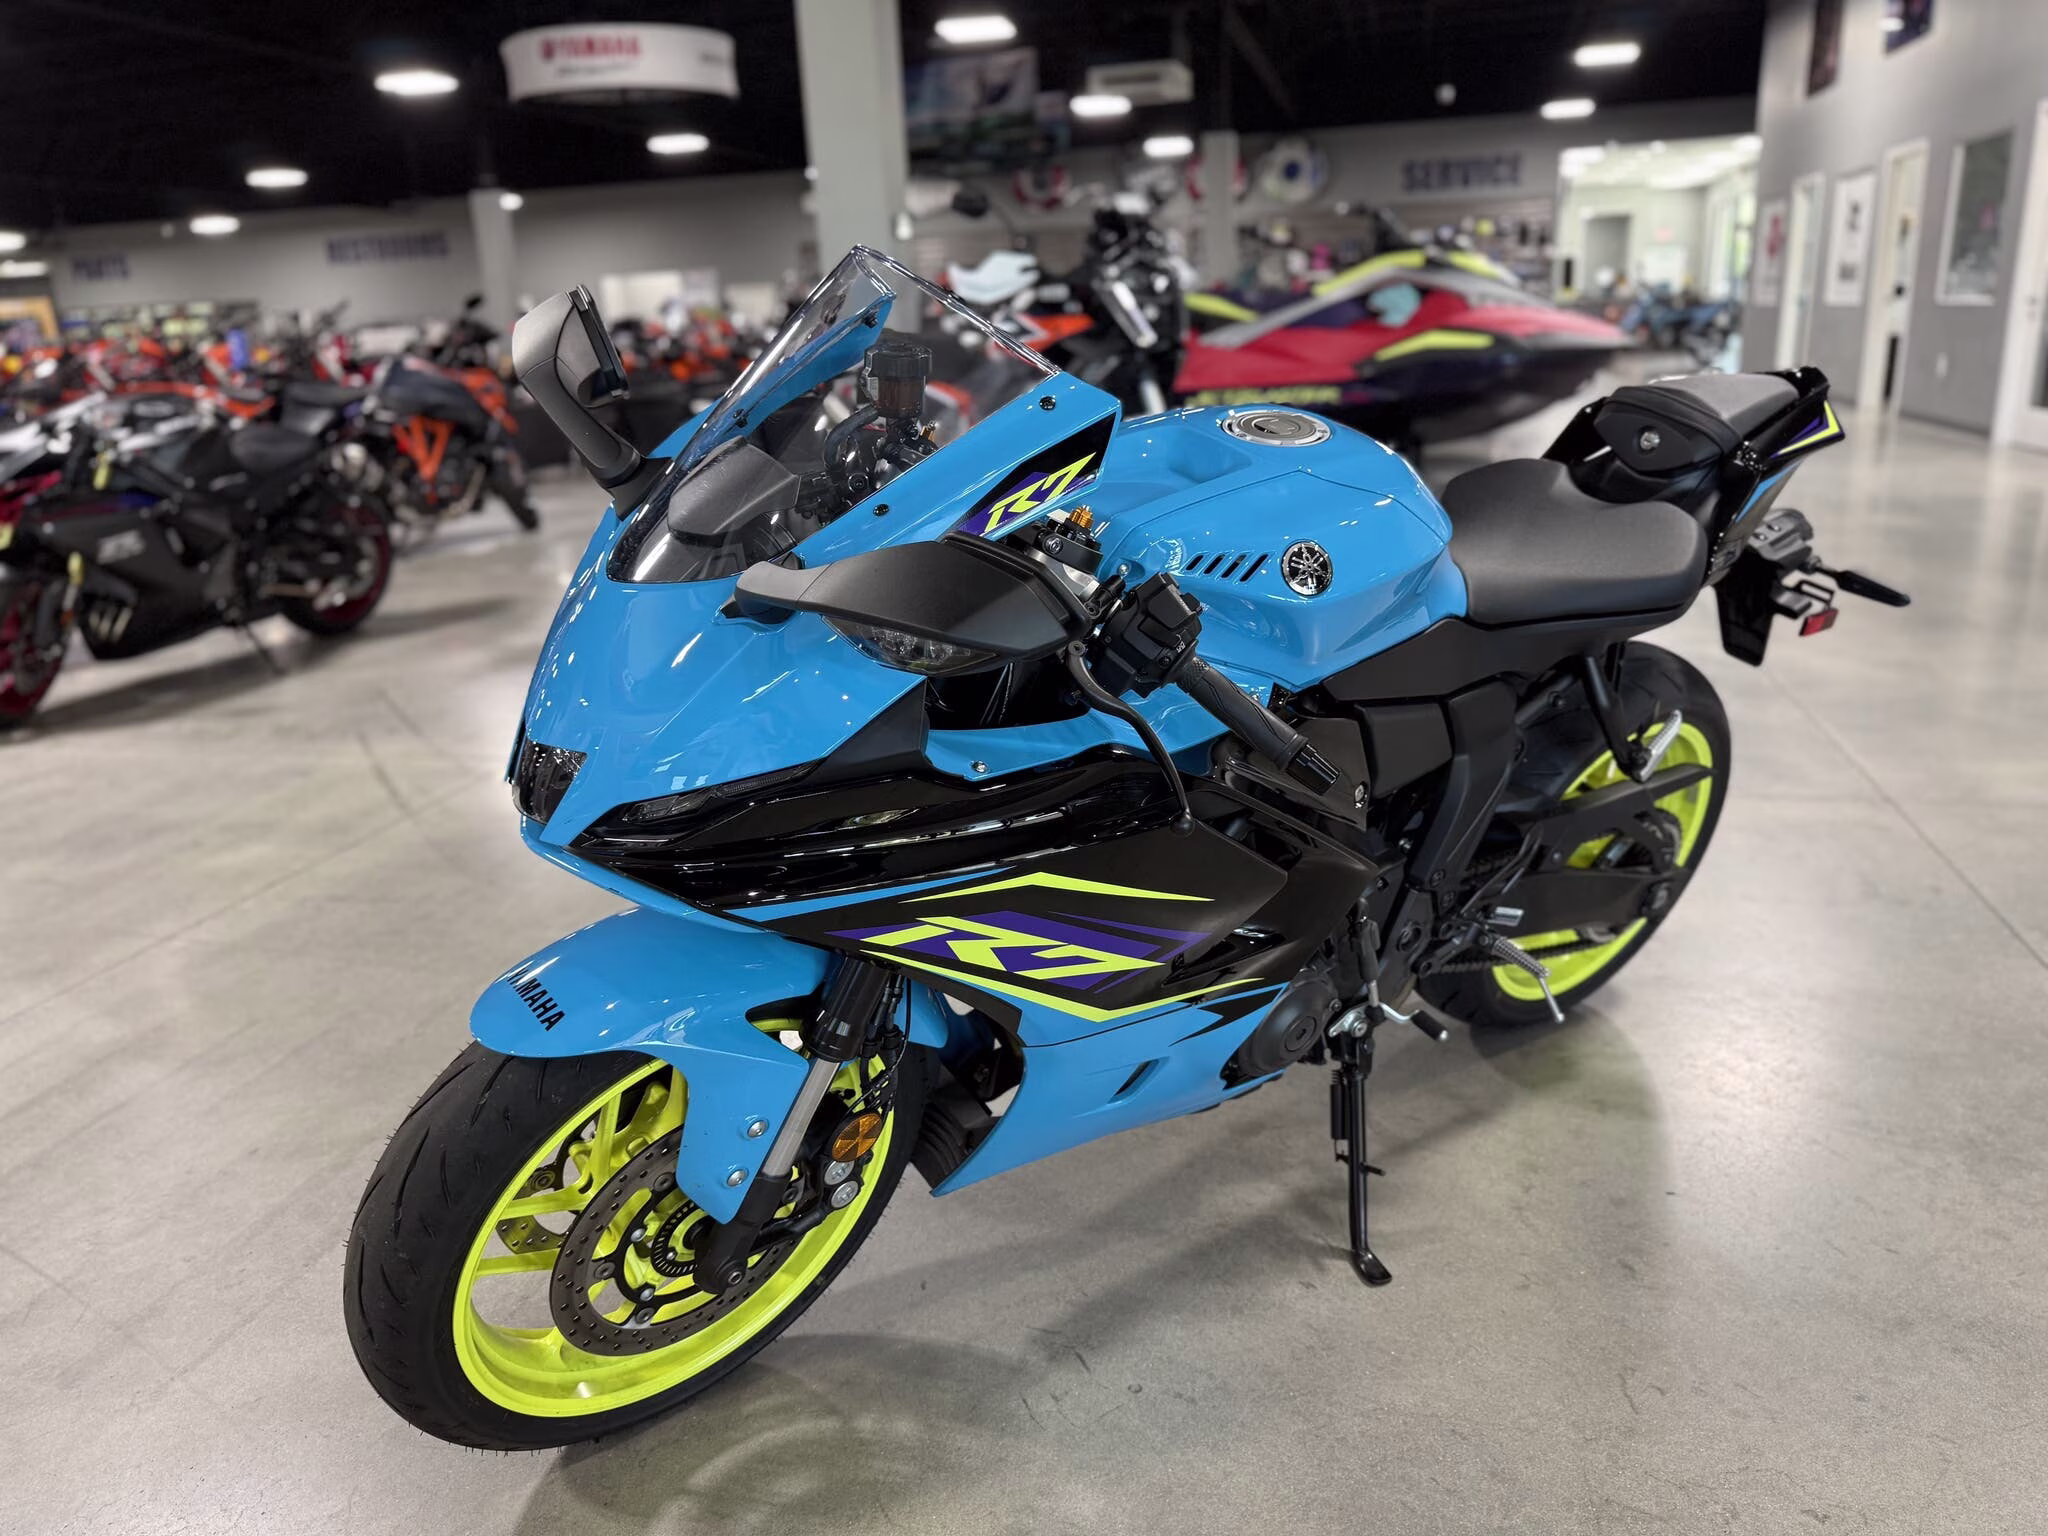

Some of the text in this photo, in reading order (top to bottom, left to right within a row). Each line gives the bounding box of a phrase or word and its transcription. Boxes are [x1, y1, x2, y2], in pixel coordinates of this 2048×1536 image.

[559, 34, 642, 60] YAMAHA
[1404, 155, 1522, 191] SERVICE
[71, 253, 130, 281] PARTS
[984, 452, 1097, 534] R7
[860, 915, 1166, 981] R7
[507, 967, 566, 1032] YAMAHA
